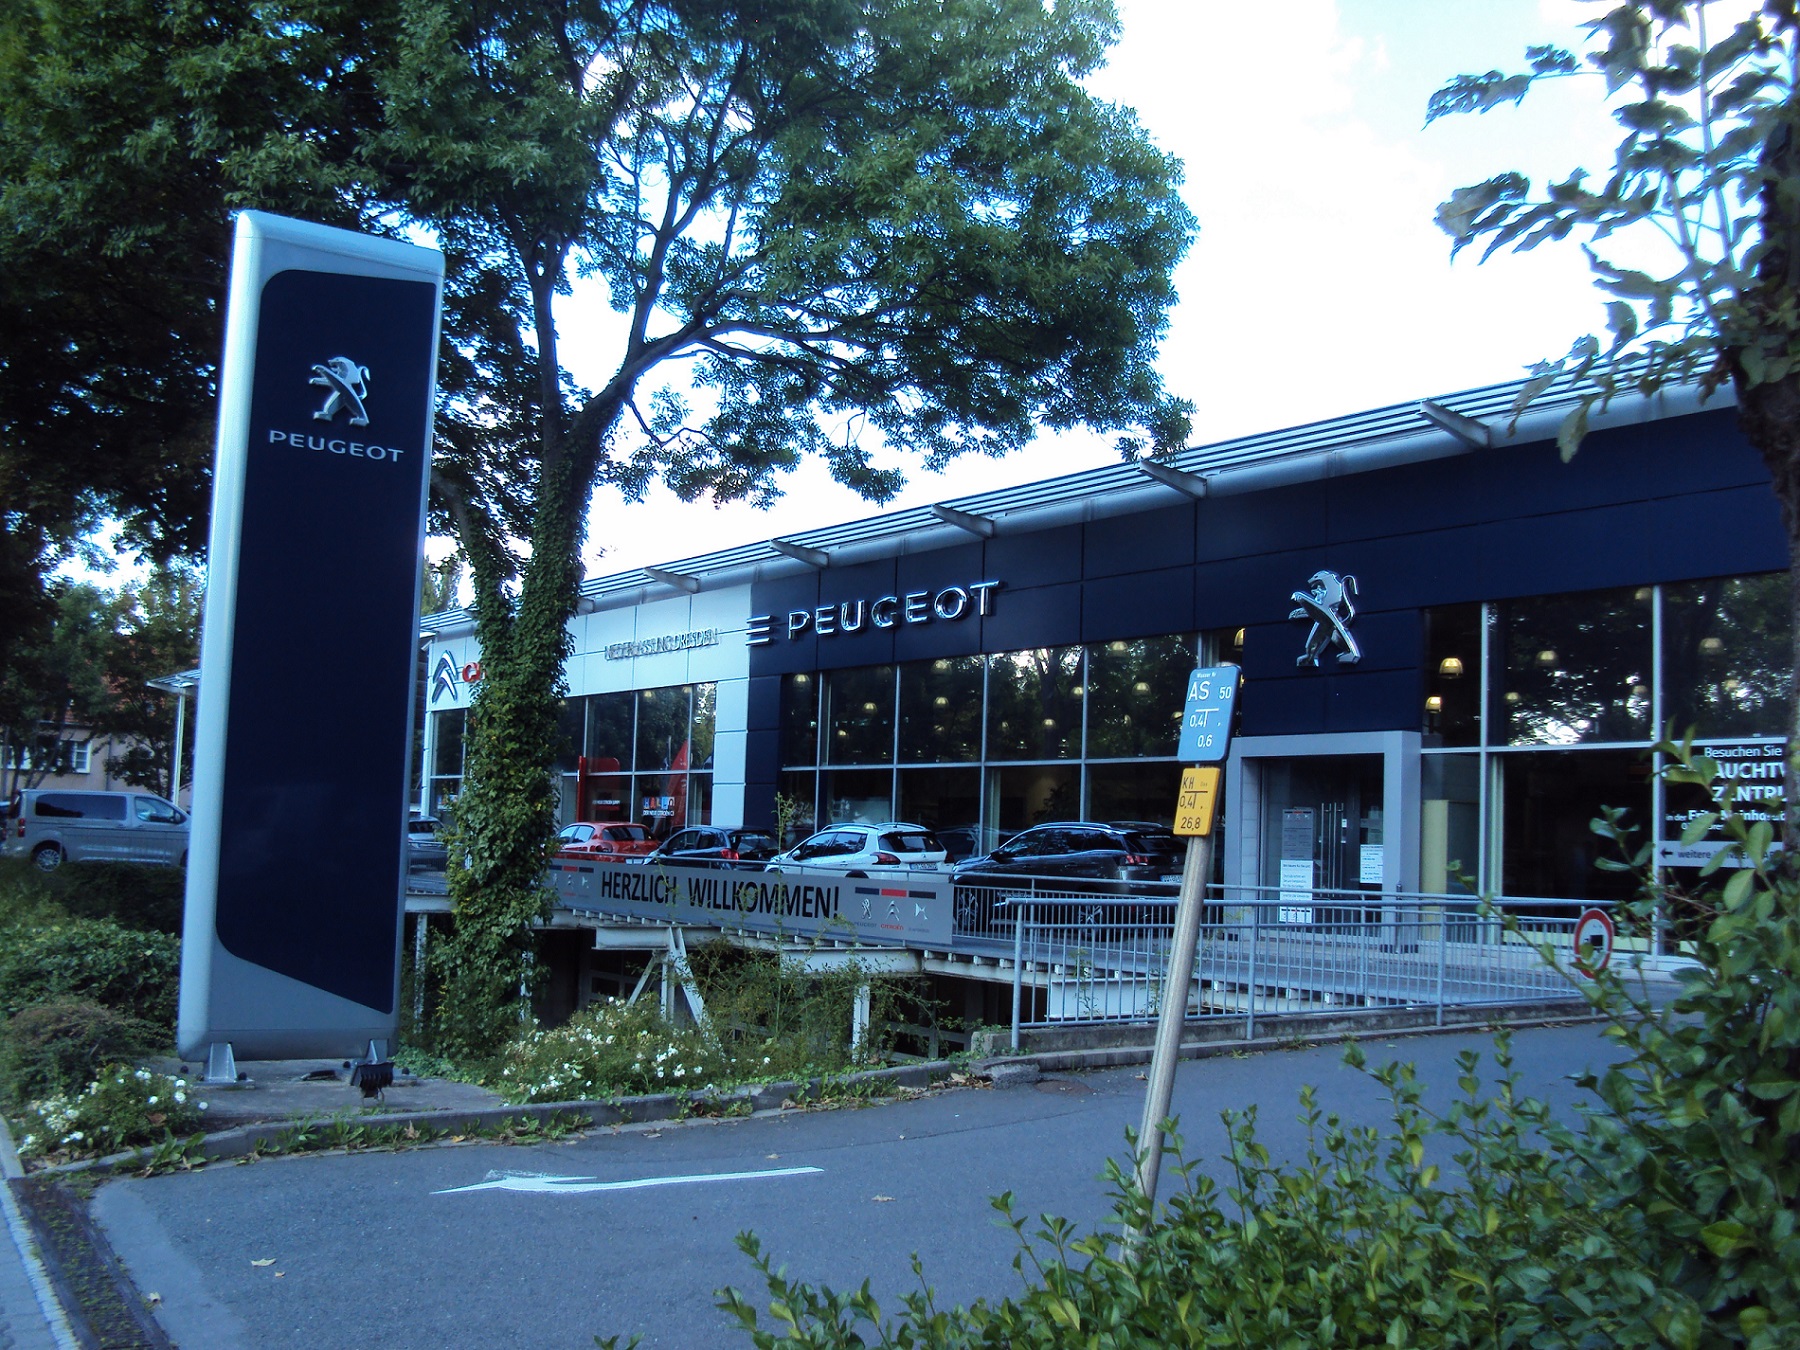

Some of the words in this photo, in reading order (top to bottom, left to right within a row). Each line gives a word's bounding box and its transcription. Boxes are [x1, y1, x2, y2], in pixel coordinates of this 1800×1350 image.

[269, 430, 404, 462] PEUGEOT
[788, 580, 1001, 640] PEUGEOT
[1187, 680, 1211, 702] AS
[1218, 686, 1232, 700] 50
[1197, 734, 1213, 748] 0,6
[1704, 746, 1761, 758] Besuchen
[1763, 745, 1783, 757] Sie
[1182, 776, 1195, 790] KH
[1180, 817, 1201, 831] 26,8
[600, 871, 678, 904] HERZLICH
[688, 877, 840, 919] WILLKOMMEN!
